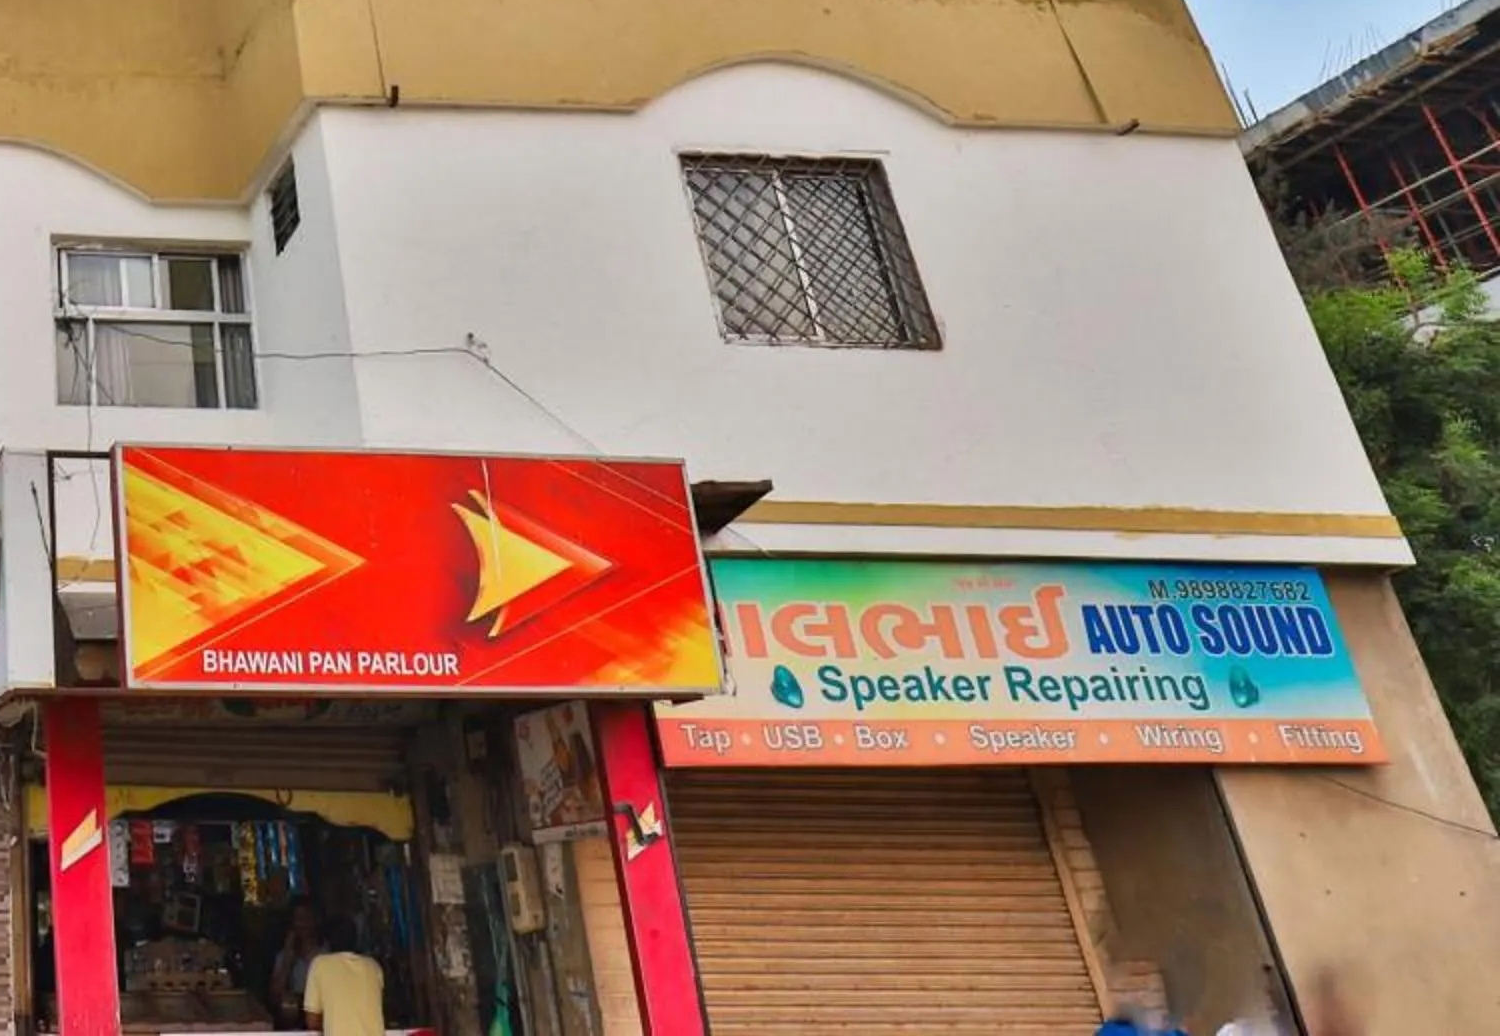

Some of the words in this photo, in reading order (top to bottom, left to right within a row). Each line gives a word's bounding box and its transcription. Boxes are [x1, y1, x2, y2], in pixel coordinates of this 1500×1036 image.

[1081, 603, 1192, 656] AUTO
[1191, 603, 1334, 658] SOUND
[202, 649, 304, 675] BHAWANI
[309, 652, 352, 675] PAN
[357, 652, 460, 677] PARLOUR
[816, 664, 992, 710] Speaker
[1003, 665, 1211, 712] Repairing
[680, 724, 733, 753] Tap
[762, 725, 824, 750] USB
[854, 726, 909, 750] Box
[968, 725, 1077, 753] Speaker
[1135, 726, 1224, 753] Wiring
[1277, 725, 1364, 753] Fitting
